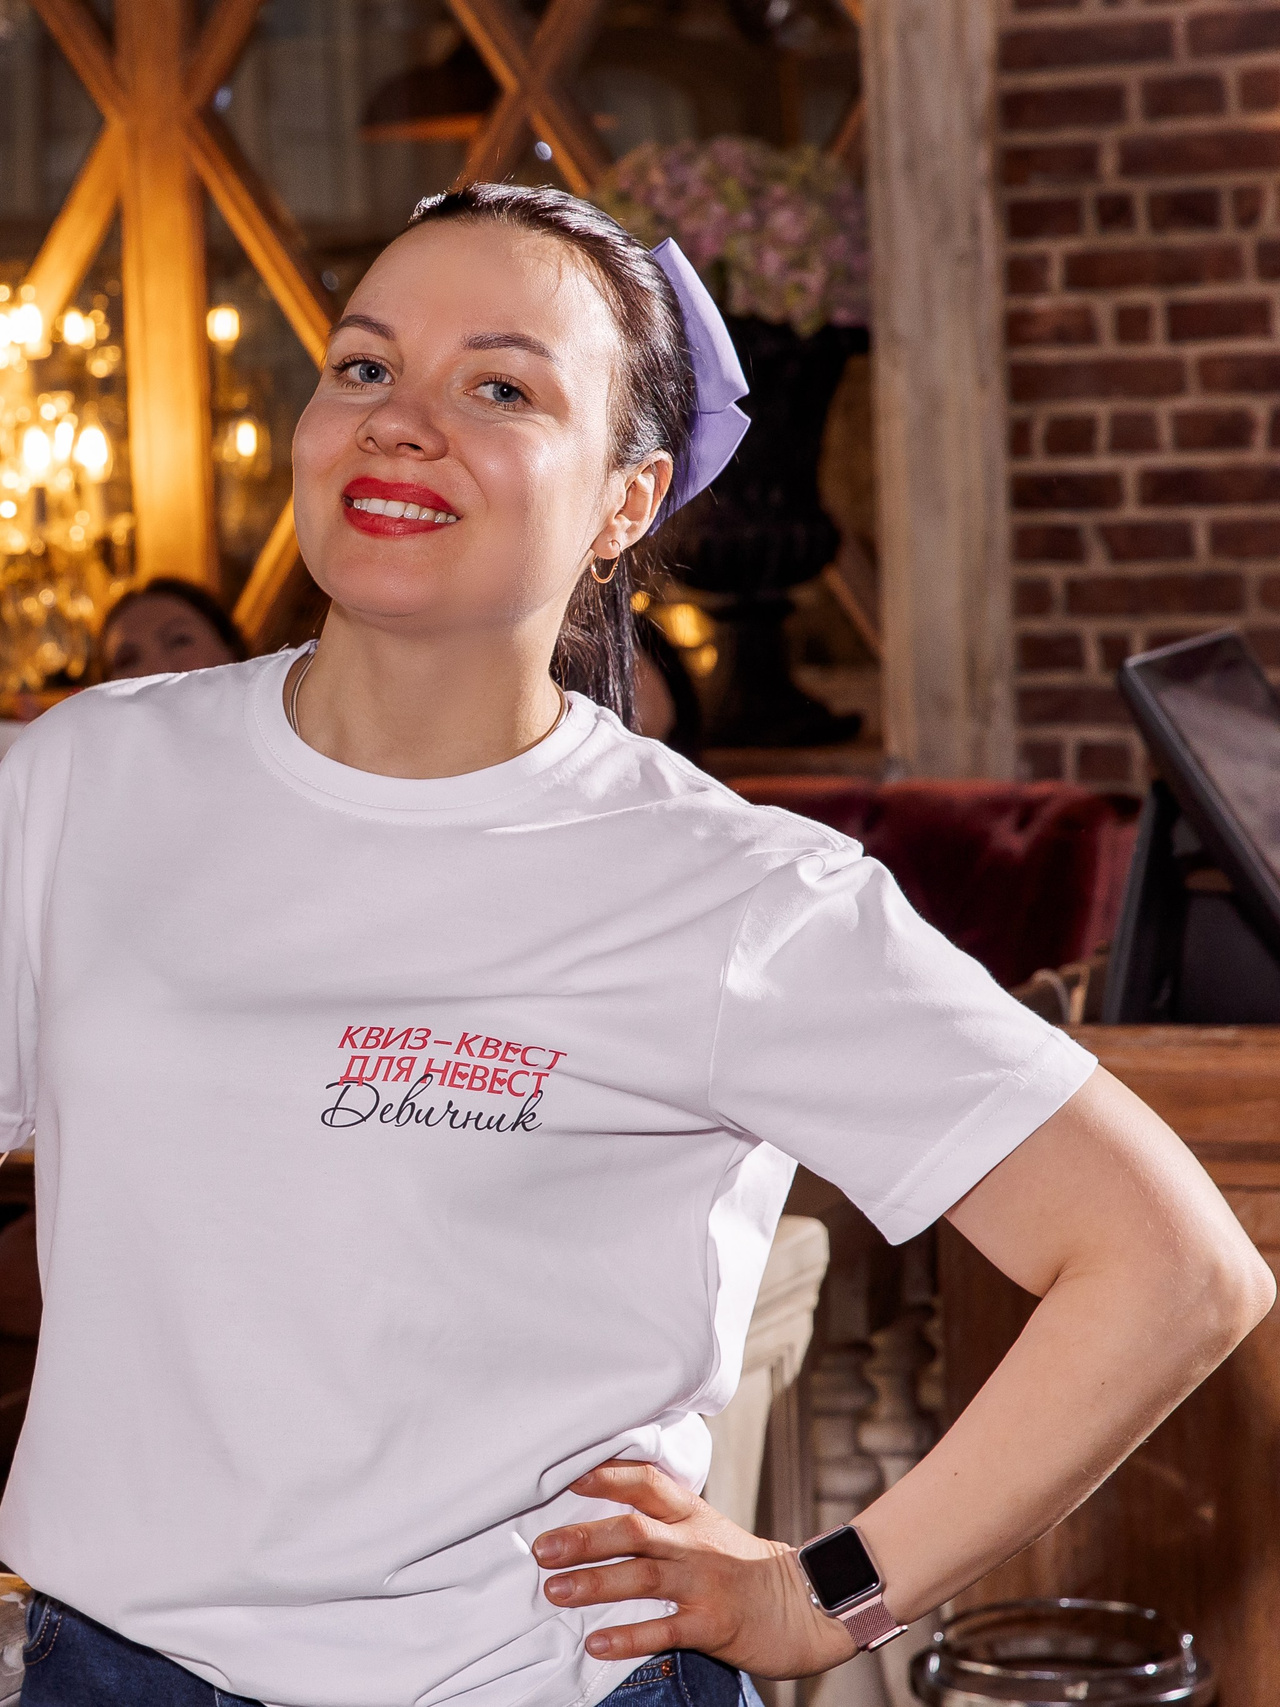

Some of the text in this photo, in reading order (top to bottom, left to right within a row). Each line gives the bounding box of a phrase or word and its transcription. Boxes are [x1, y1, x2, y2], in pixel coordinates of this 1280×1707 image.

[337, 1025, 568, 1070] КВИЗ-КВЕСТ
[336, 1055, 550, 1098] ДЛЯ НЕВЕСТ
[320, 1073, 544, 1133] Девичник
